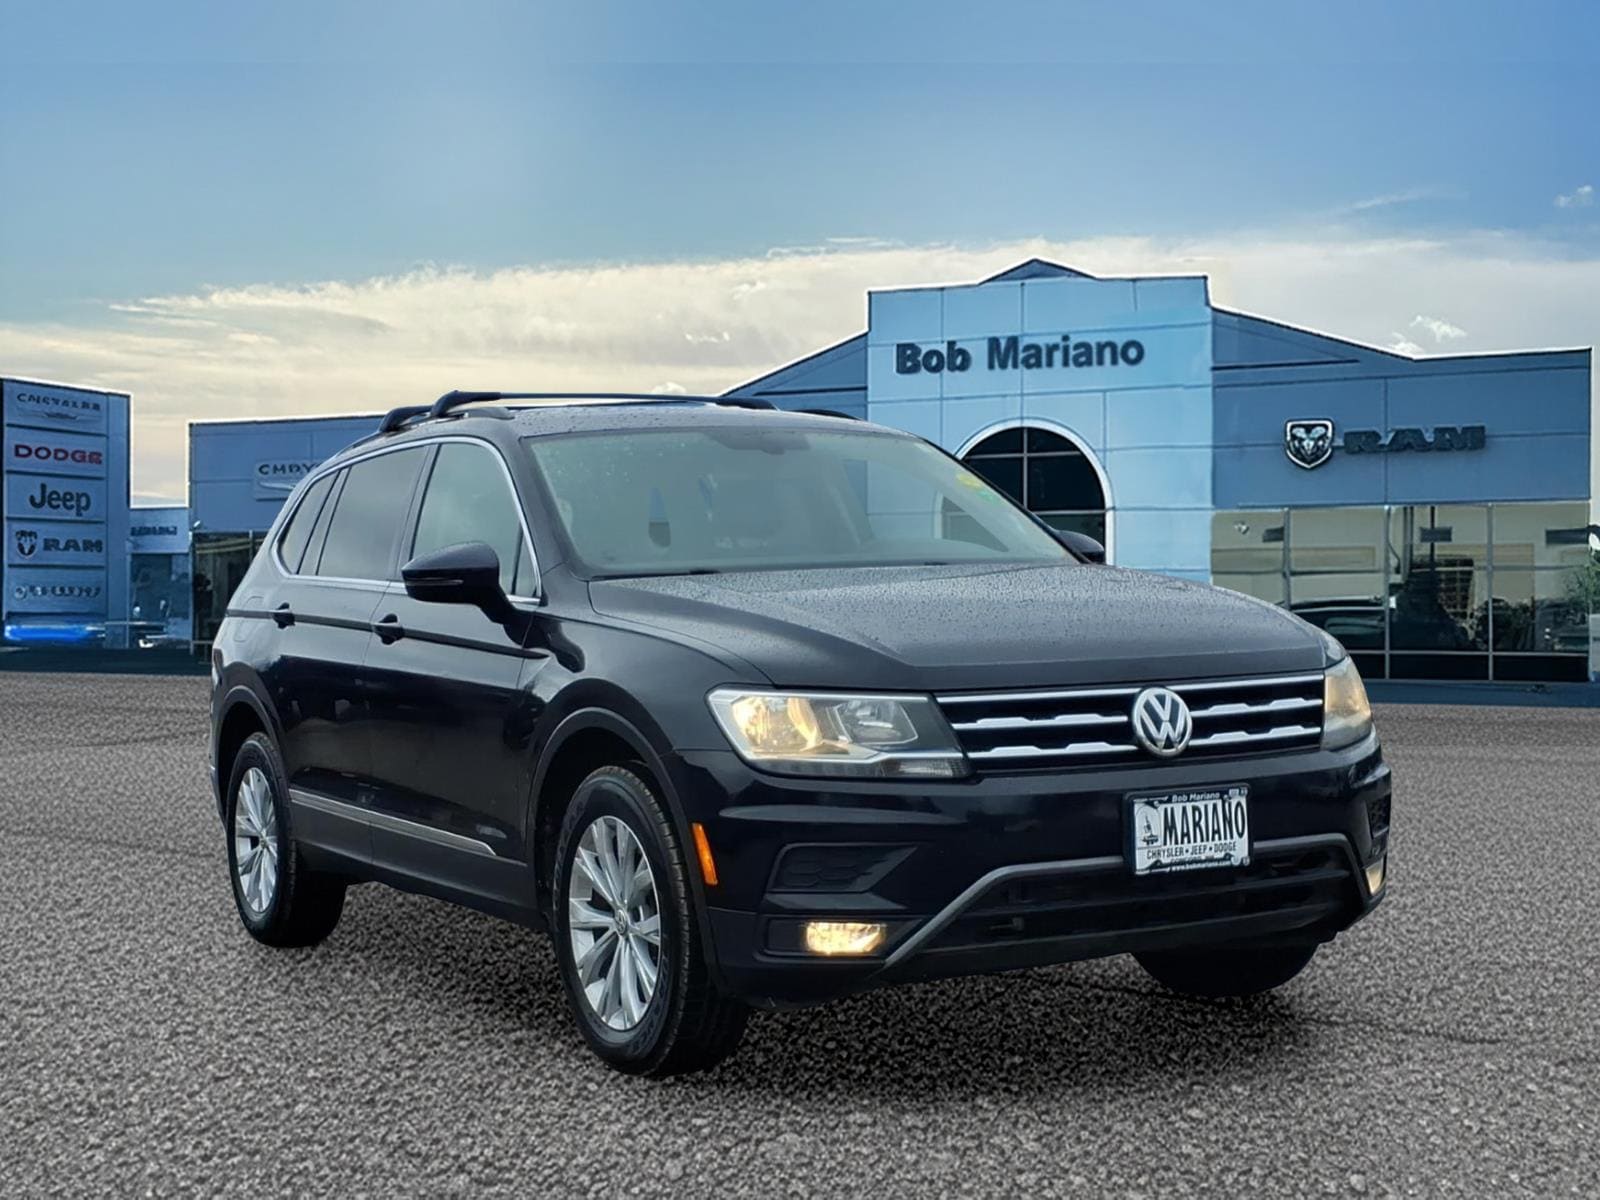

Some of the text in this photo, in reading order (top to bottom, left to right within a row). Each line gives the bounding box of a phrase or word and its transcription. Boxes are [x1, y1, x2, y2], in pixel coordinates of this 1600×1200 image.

[896, 335, 1145, 374] Bob Mariano
[1343, 425, 1485, 454] RAM
[14, 444, 102, 464] DODGE
[29, 483, 92, 516] Jeep
[43, 538, 103, 553] RAM
[1172, 792, 1220, 802] Bob Mariano
[1163, 800, 1246, 847] MARIANO
[1146, 846, 1184, 860] CHRYSLER
[1190, 844, 1207, 856] JEEP
[1214, 841, 1237, 853] DODGE
